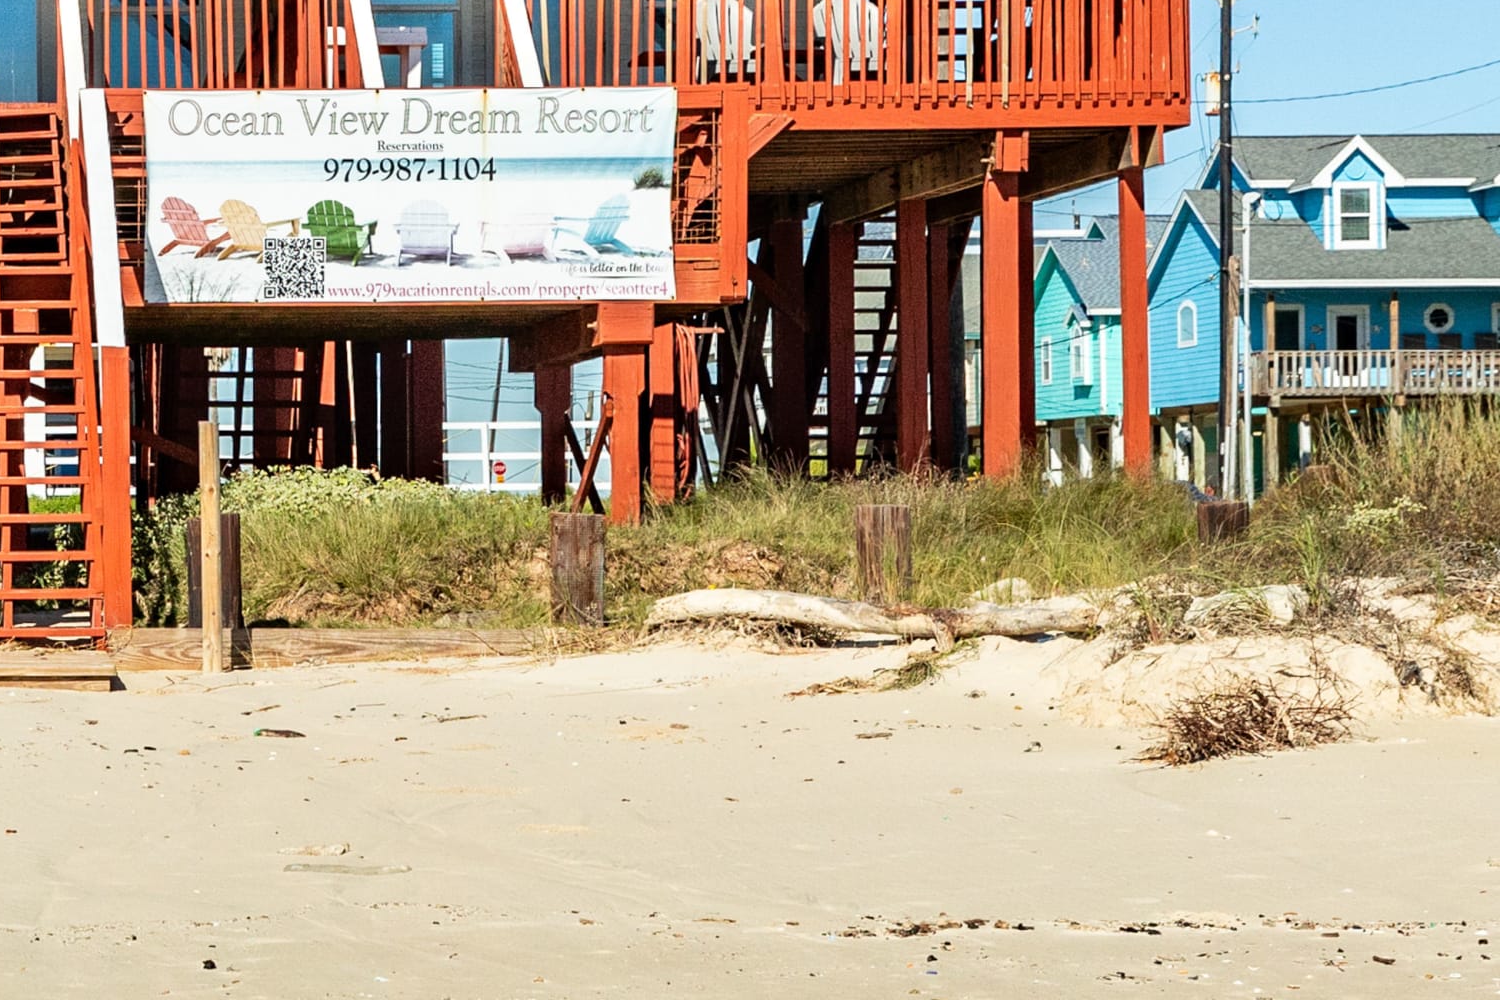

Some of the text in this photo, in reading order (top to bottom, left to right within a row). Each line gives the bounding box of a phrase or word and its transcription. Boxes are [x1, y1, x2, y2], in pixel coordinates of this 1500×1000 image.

[167, 95, 655, 137] Ocean View Dream Resort
[376, 139, 445, 153] Reservations
[323, 156, 497, 183] 979-987-1104
[589, 261, 614, 273] better
[615, 265, 628, 273] on
[629, 262, 643, 273] the
[327, 281, 669, 299] www.979vacationrentals.com/property/seaotter4
